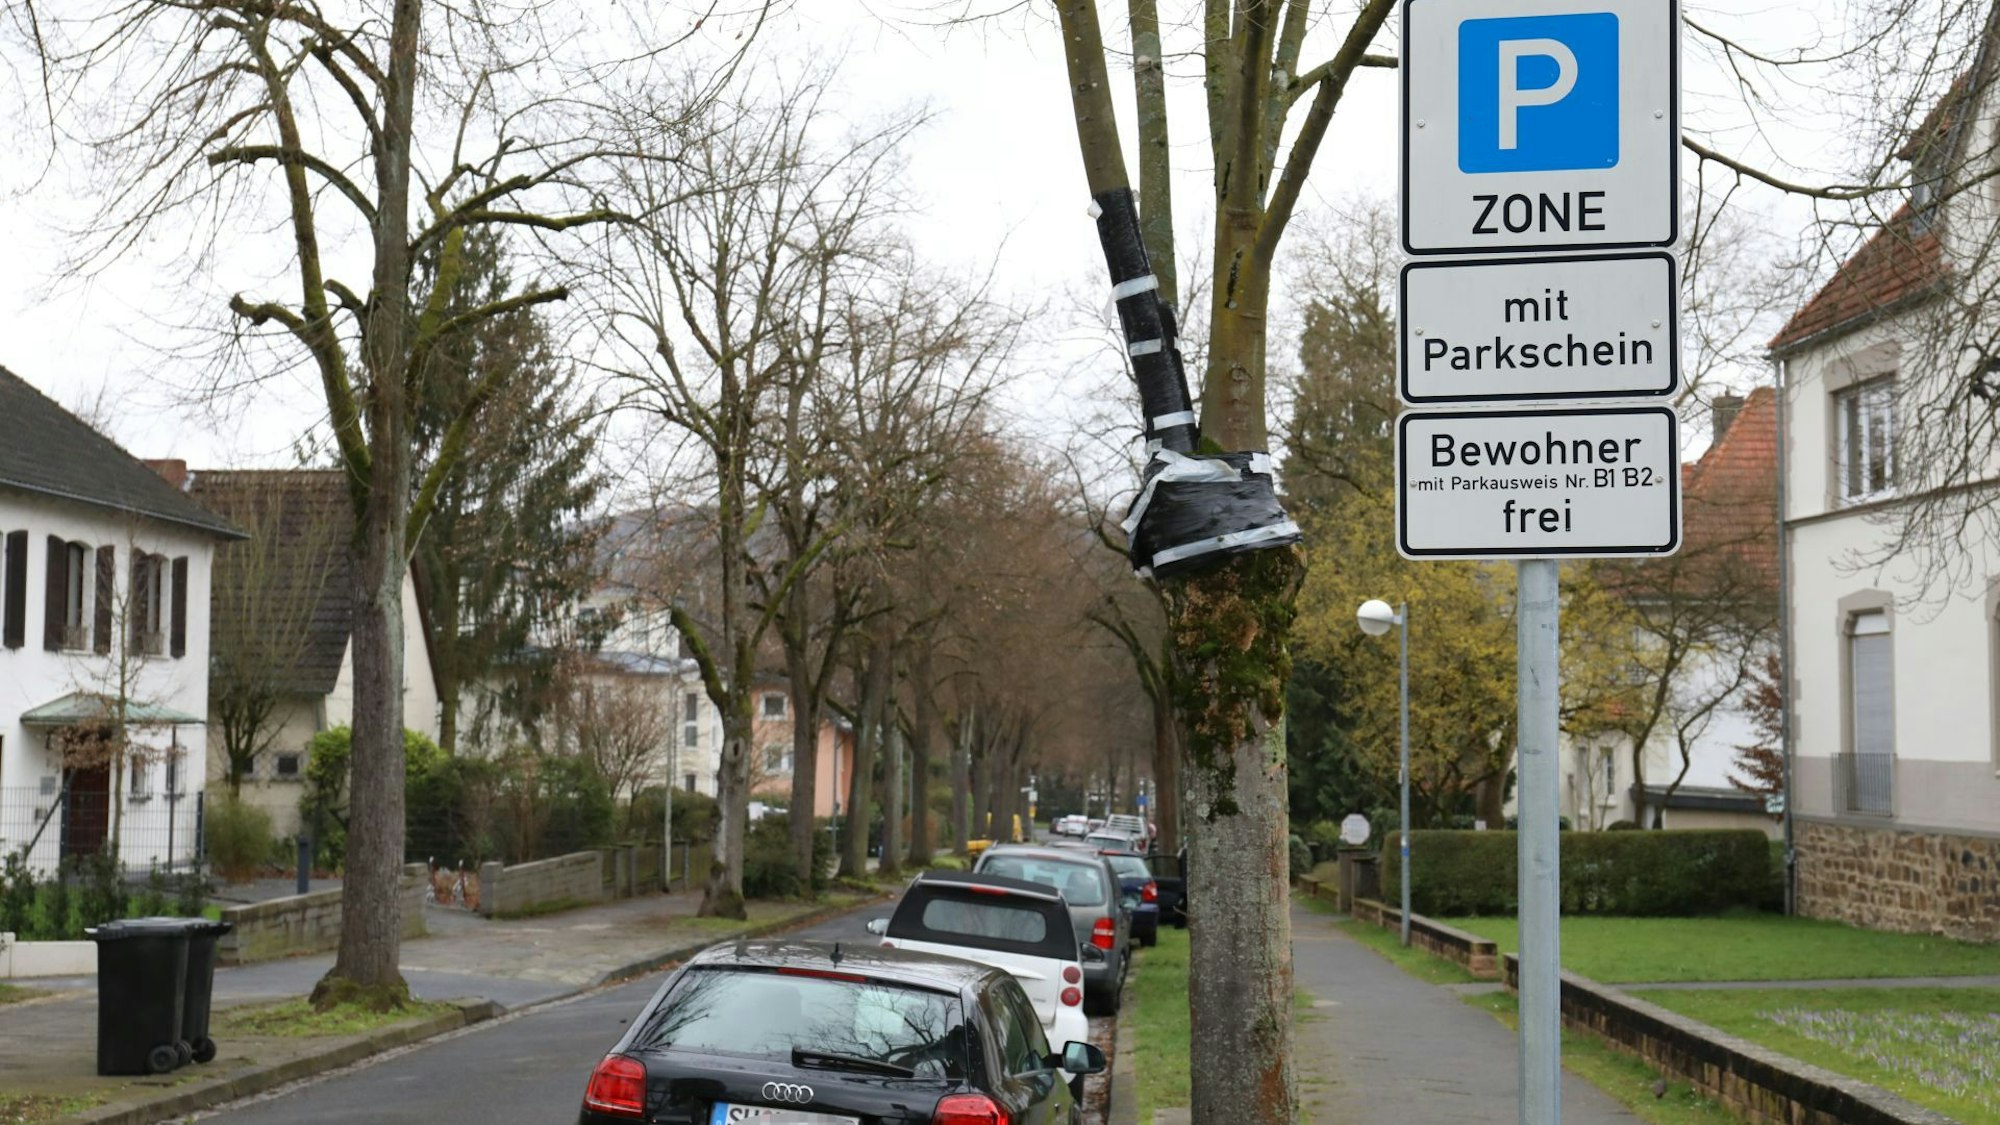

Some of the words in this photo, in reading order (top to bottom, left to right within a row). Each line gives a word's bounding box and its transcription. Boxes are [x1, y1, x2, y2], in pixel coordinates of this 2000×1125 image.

[1499, 38, 1578, 149] P
[1472, 191, 1605, 234] ZONE
[1504, 289, 1568, 322] mit
[1424, 332, 1652, 371] Parkschein
[1431, 431, 1641, 467] Bewohner
[1418, 477, 1444, 490] mit
[1451, 476, 1557, 489] Parkausweis
[1566, 474, 1588, 488] Nr.
[1503, 499, 1571, 532] frei
